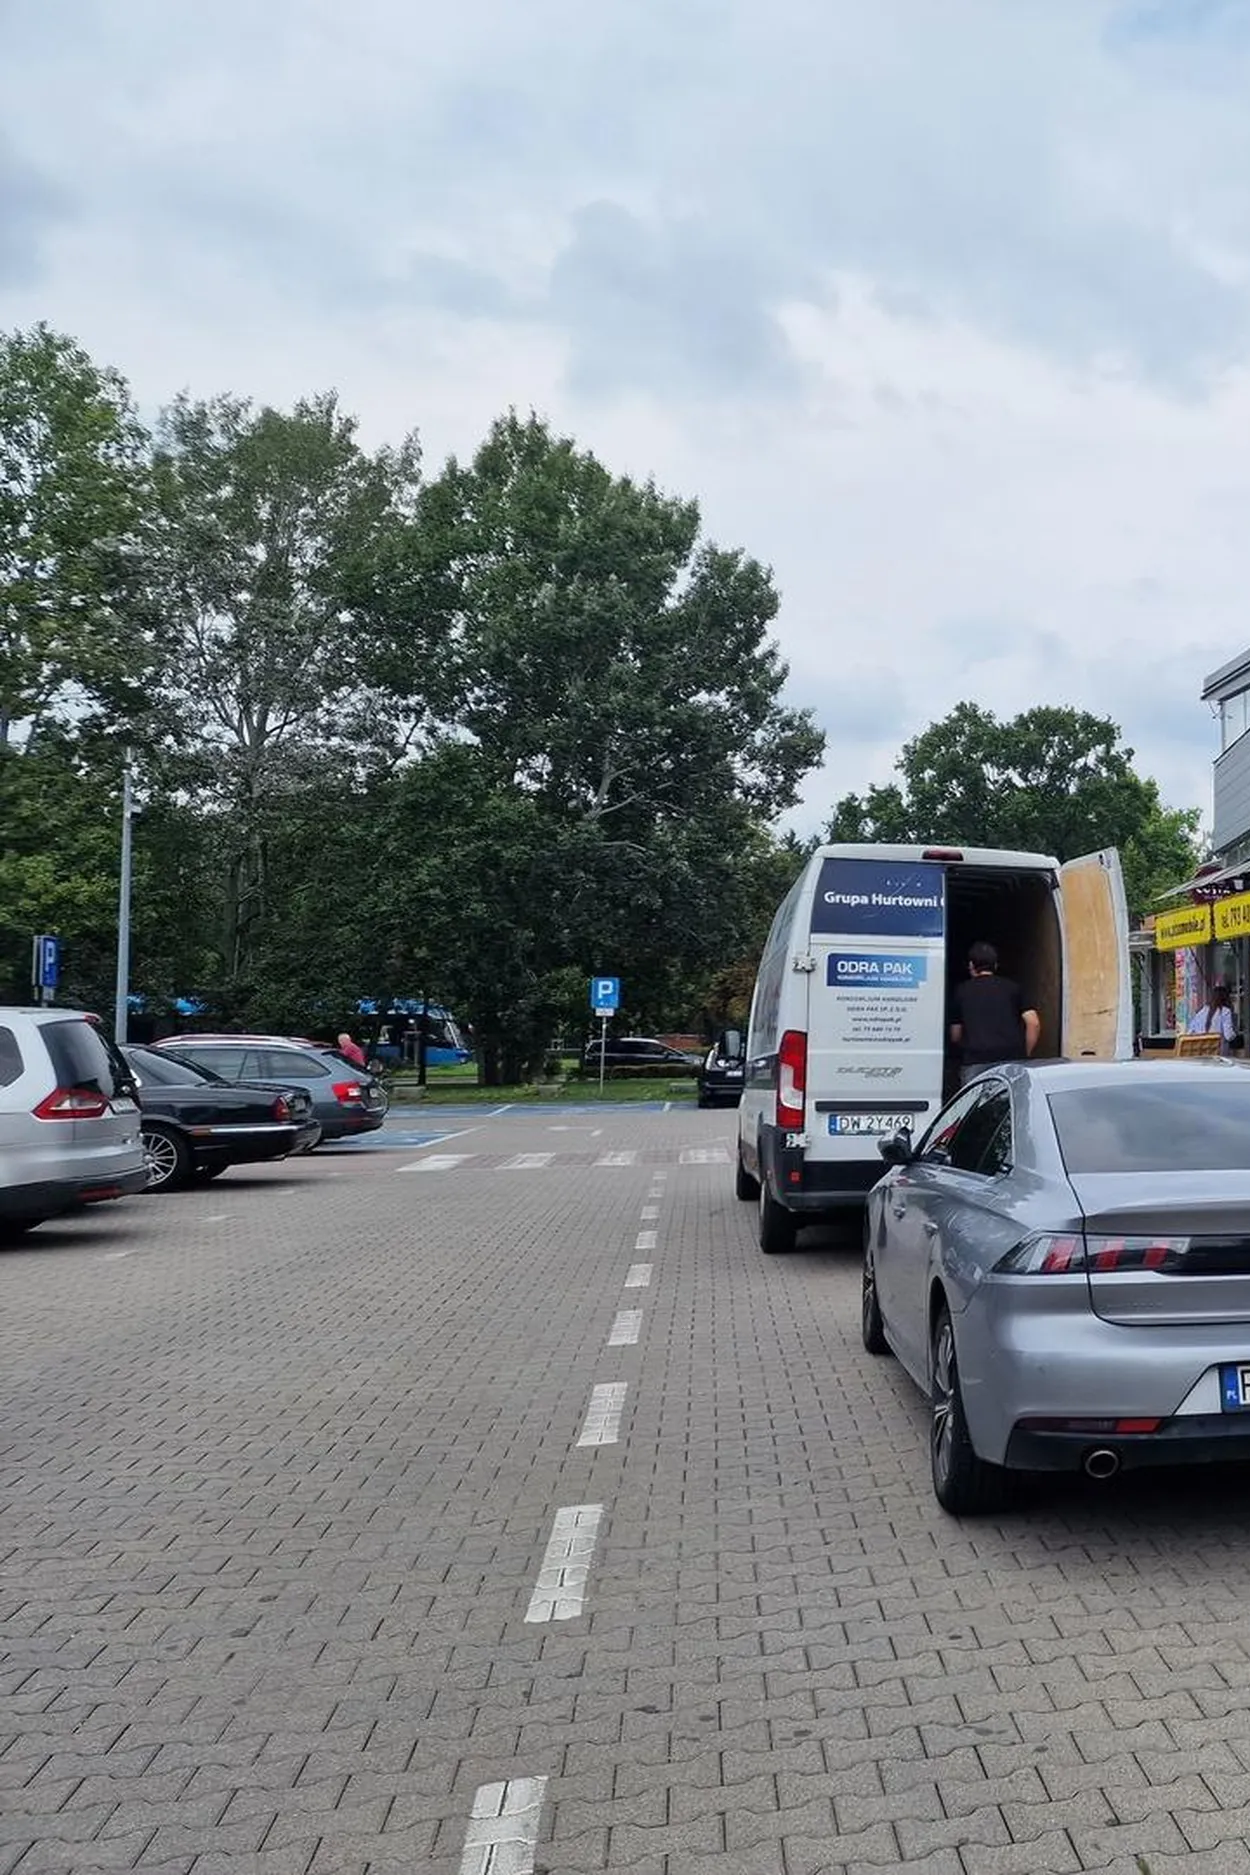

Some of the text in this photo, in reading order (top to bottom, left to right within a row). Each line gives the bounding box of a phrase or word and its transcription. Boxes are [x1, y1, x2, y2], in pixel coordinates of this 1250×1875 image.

[824, 891, 869, 907] Grupa
[872, 893, 938, 908] Hurtowni
[836, 960, 914, 975] ODRA PAK
[598, 980, 614, 999] P
[840, 1116, 861, 1130] DW
